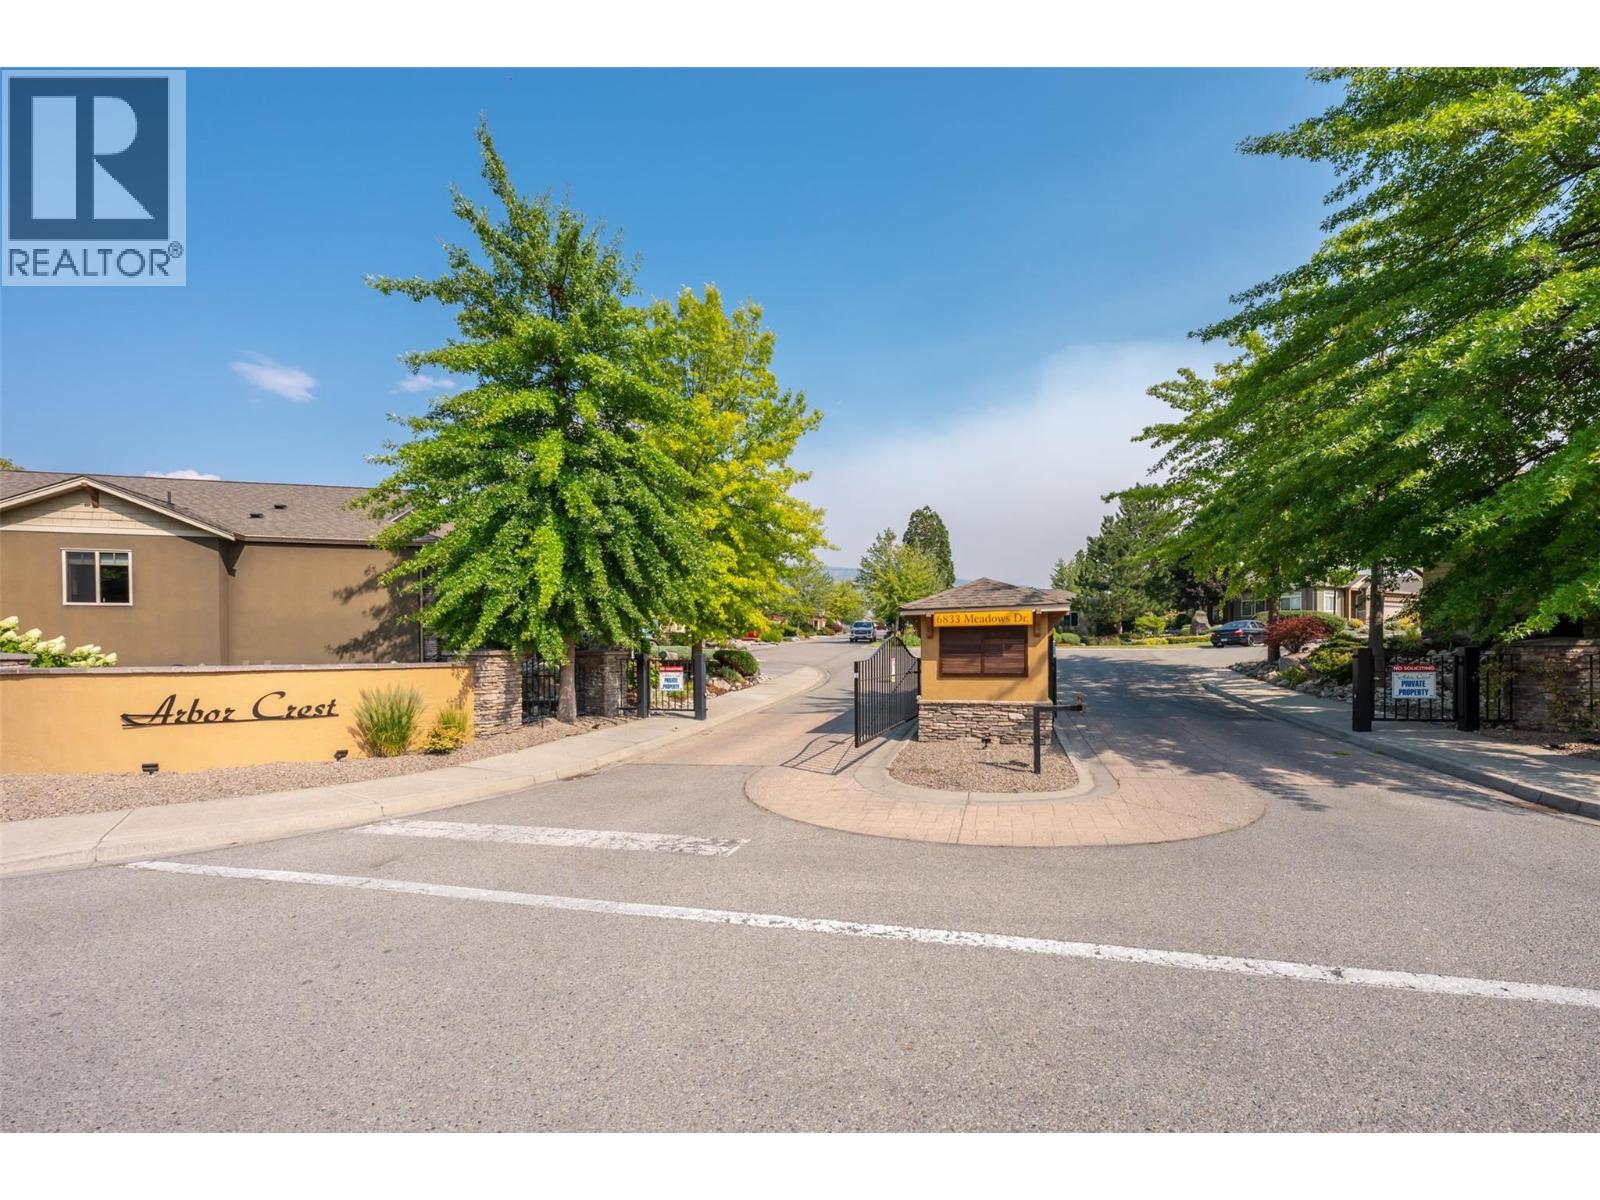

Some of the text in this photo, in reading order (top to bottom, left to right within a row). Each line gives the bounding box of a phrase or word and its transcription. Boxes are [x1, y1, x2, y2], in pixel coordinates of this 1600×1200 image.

[936, 612, 1029, 625] 6833 Meadows Dr.
[1398, 688, 1429, 696] PROPERTY
[120, 691, 339, 729] Arbor Crest
